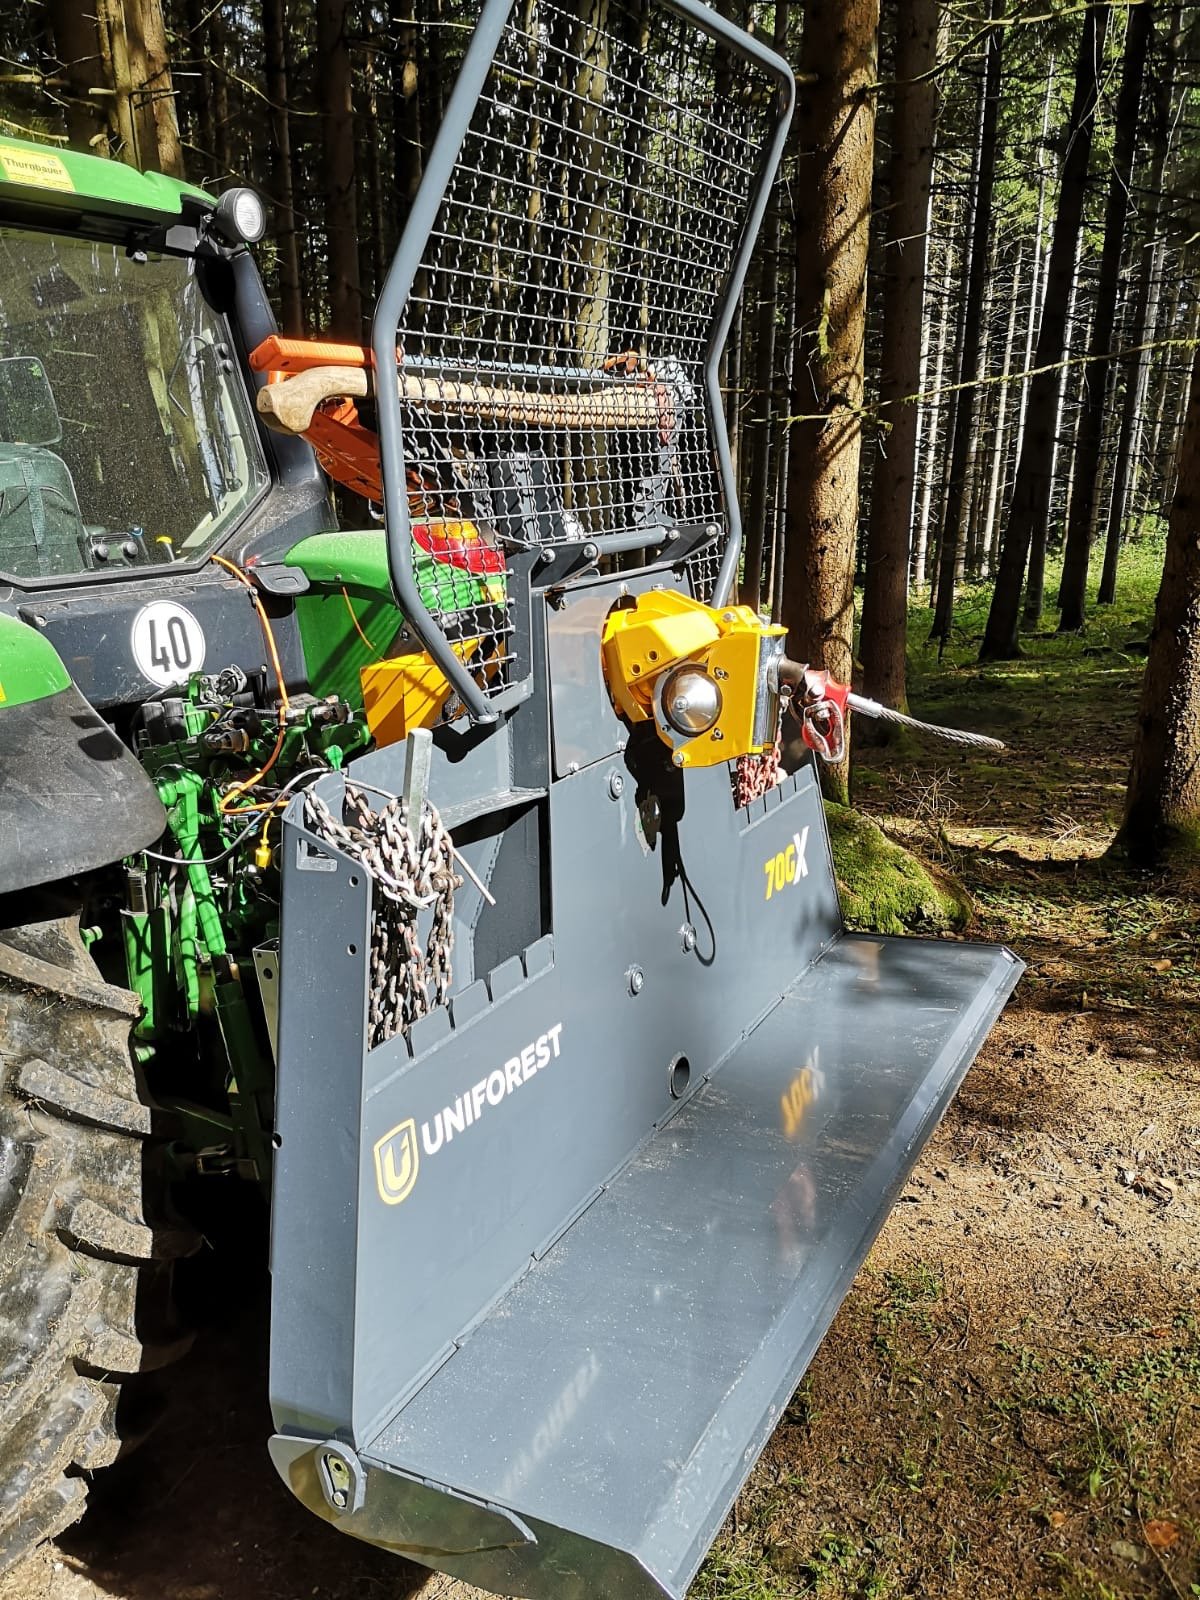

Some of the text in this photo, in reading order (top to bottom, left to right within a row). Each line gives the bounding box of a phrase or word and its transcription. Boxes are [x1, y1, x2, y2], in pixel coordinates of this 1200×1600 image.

[3, 157, 63, 175] Thurnbauer
[148, 616, 192, 673] 40
[421, 1022, 563, 1155] UNIFOREST
